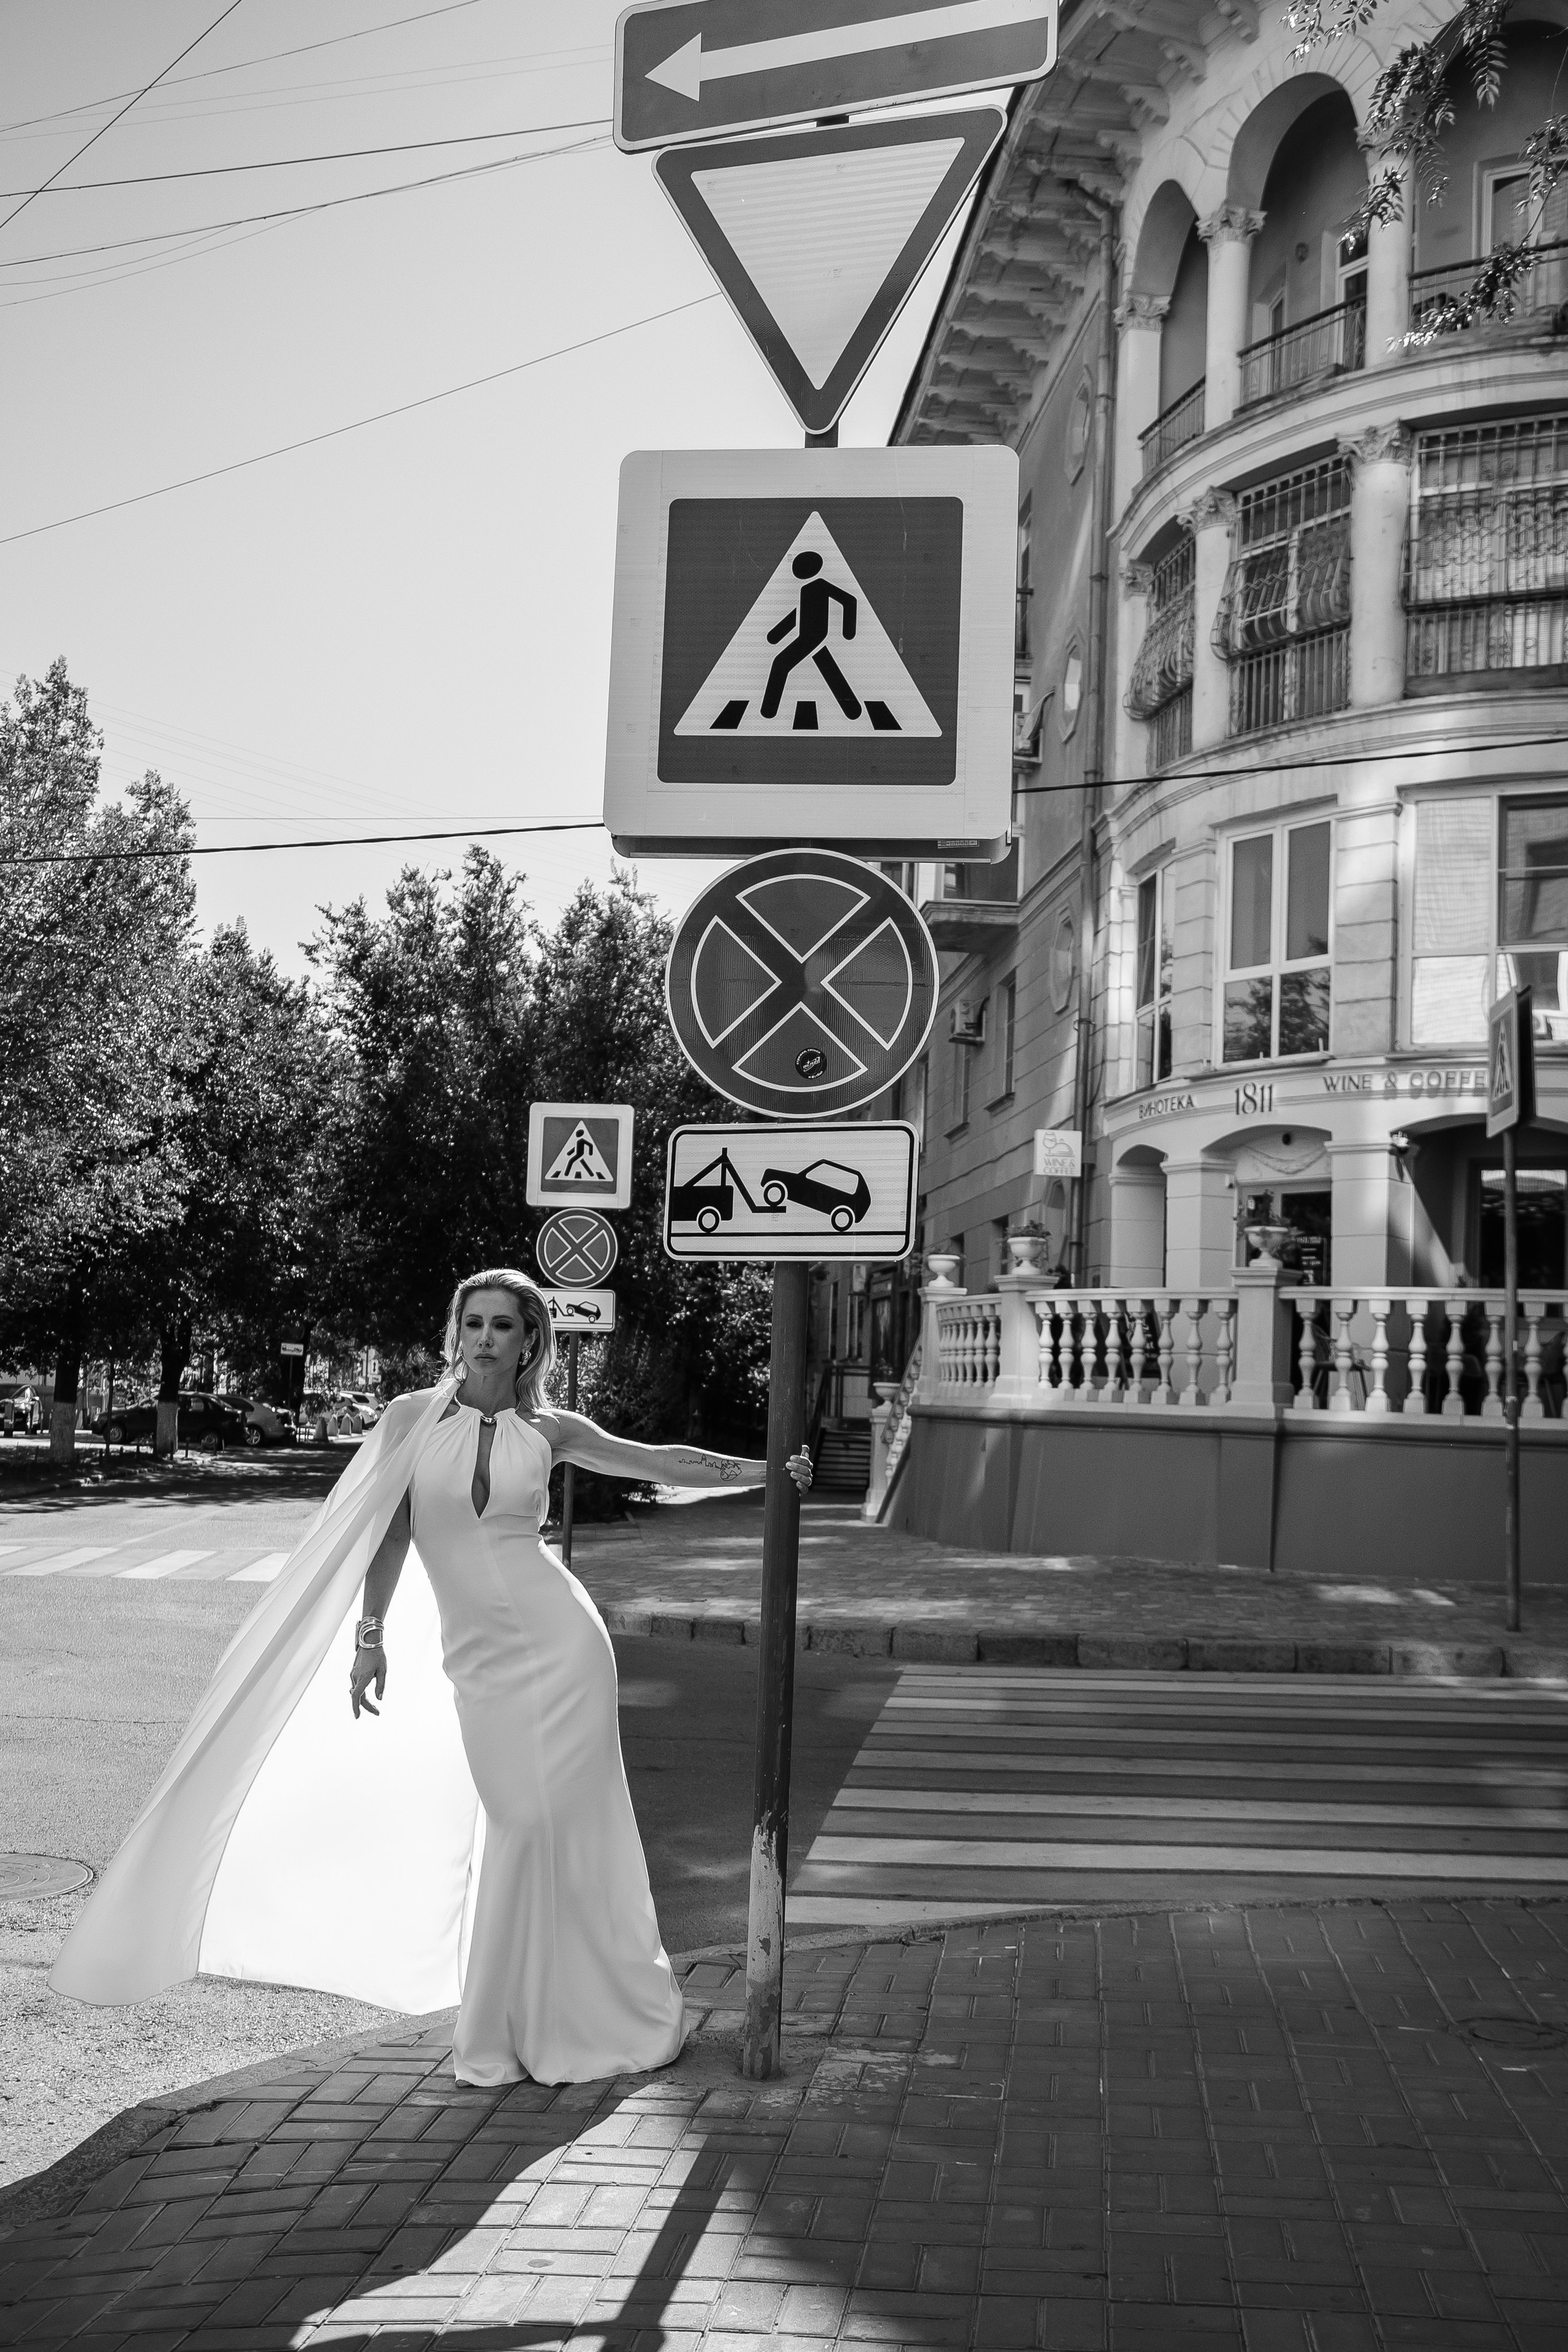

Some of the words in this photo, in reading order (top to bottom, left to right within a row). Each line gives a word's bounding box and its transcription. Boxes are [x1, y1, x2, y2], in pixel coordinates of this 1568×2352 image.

[1323, 1074, 1371, 1091] WINE
[1385, 1072, 1396, 1088] &
[1411, 1071, 1486, 1088] COFFE
[1139, 1093, 1194, 1119] ВИНОТЕКА
[1235, 1082, 1273, 1115] 1811
